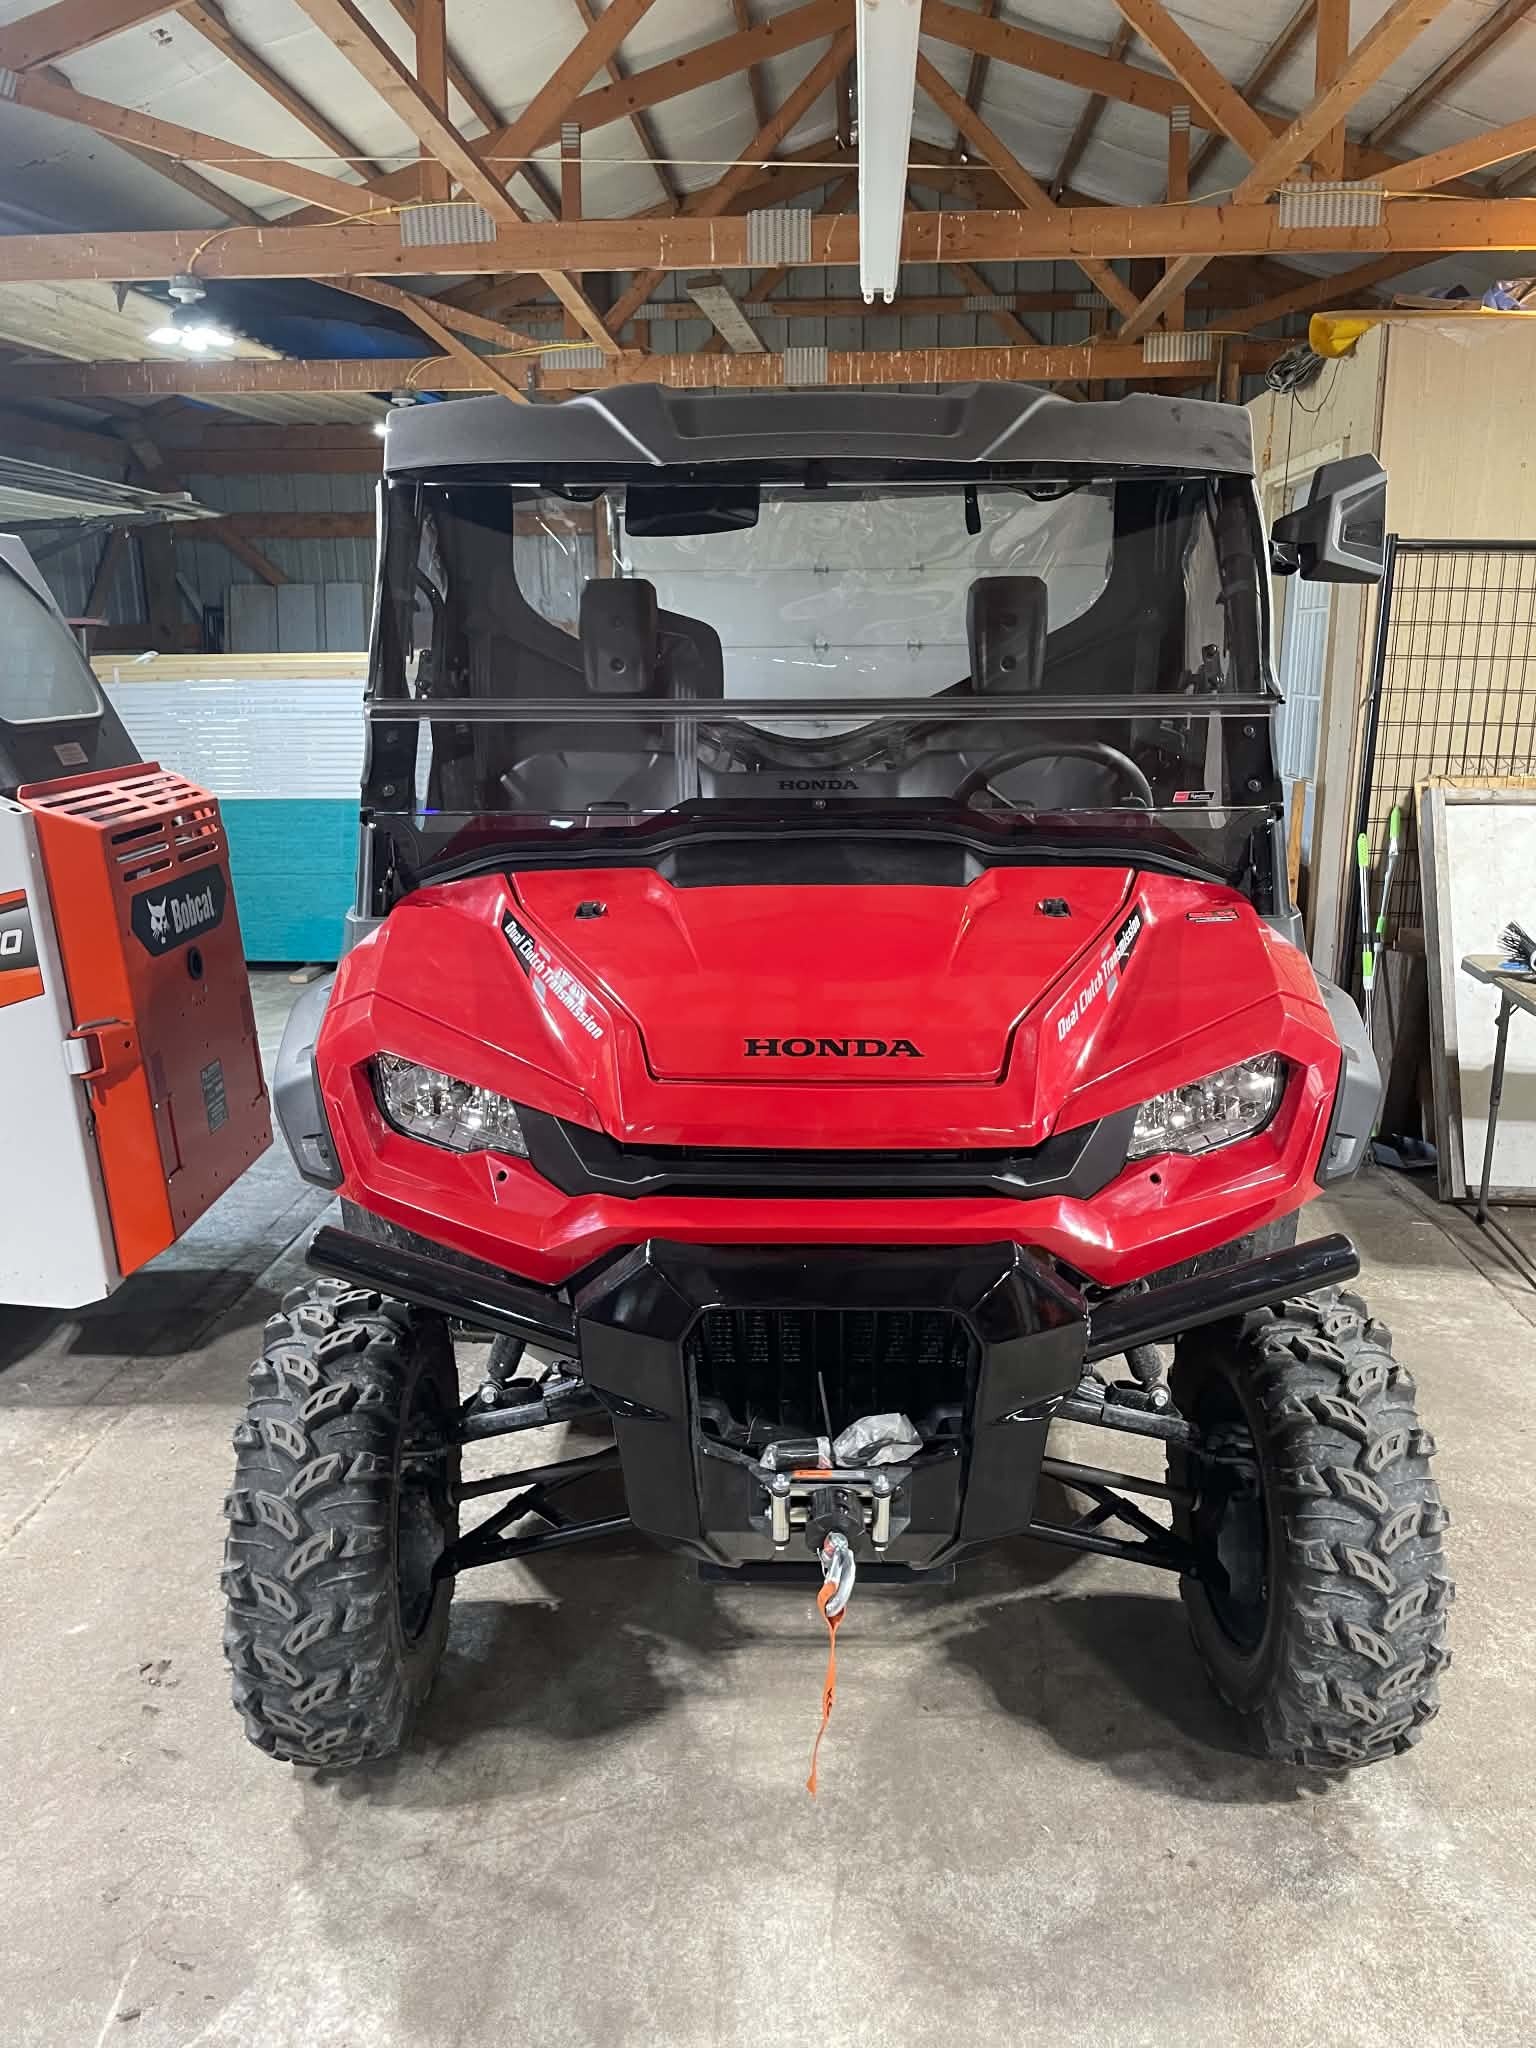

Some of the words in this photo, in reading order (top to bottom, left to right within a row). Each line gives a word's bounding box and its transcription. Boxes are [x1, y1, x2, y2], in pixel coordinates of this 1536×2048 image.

[779, 780, 859, 791] HONDA
[170, 885, 215, 934] Bobcat
[0, 928, 23, 956] 0
[504, 920, 526, 947] Dual
[519, 938, 546, 974] Clutch
[541, 966, 604, 1039] Transmission
[1057, 1001, 1079, 1041] Dual
[1080, 970, 1104, 1014] Clutch
[1101, 915, 1141, 980] Transmission
[743, 1038, 925, 1058] HONDA
